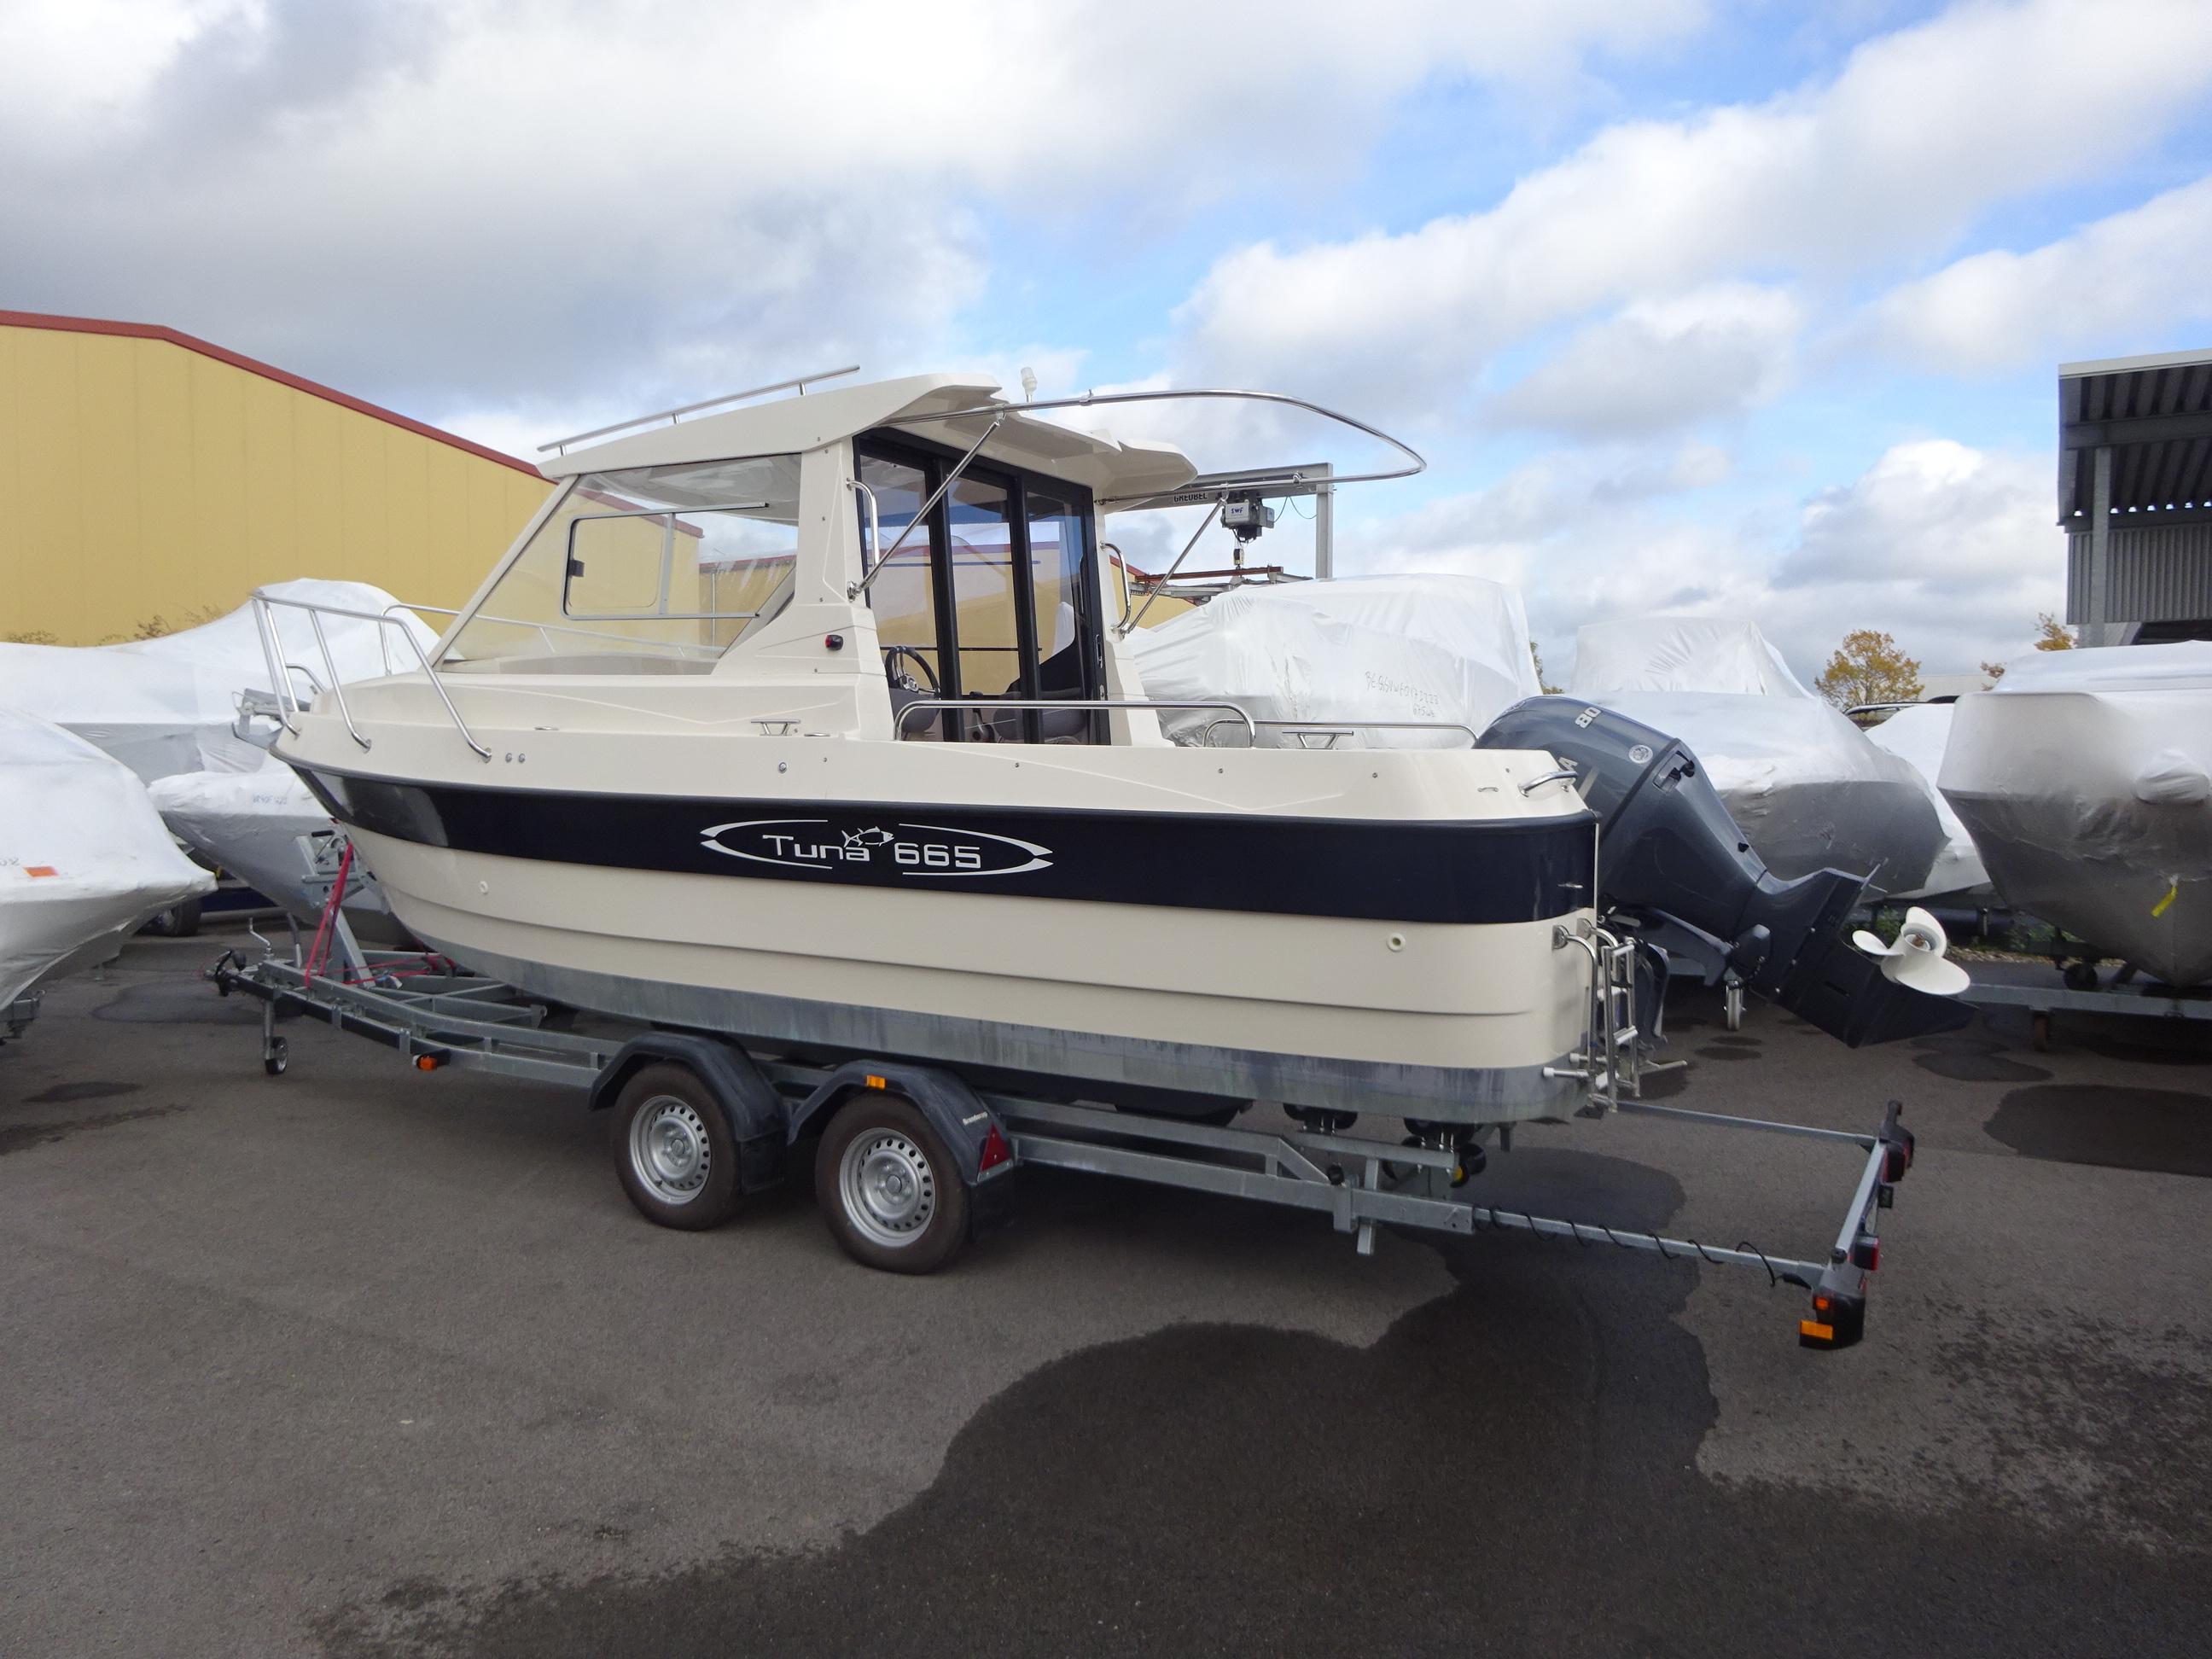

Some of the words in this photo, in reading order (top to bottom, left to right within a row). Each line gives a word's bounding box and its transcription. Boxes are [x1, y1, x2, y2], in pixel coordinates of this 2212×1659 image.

[1575, 707, 1601, 729] 80
[762, 834, 870, 862] Tuna
[894, 842, 981, 869] 665
